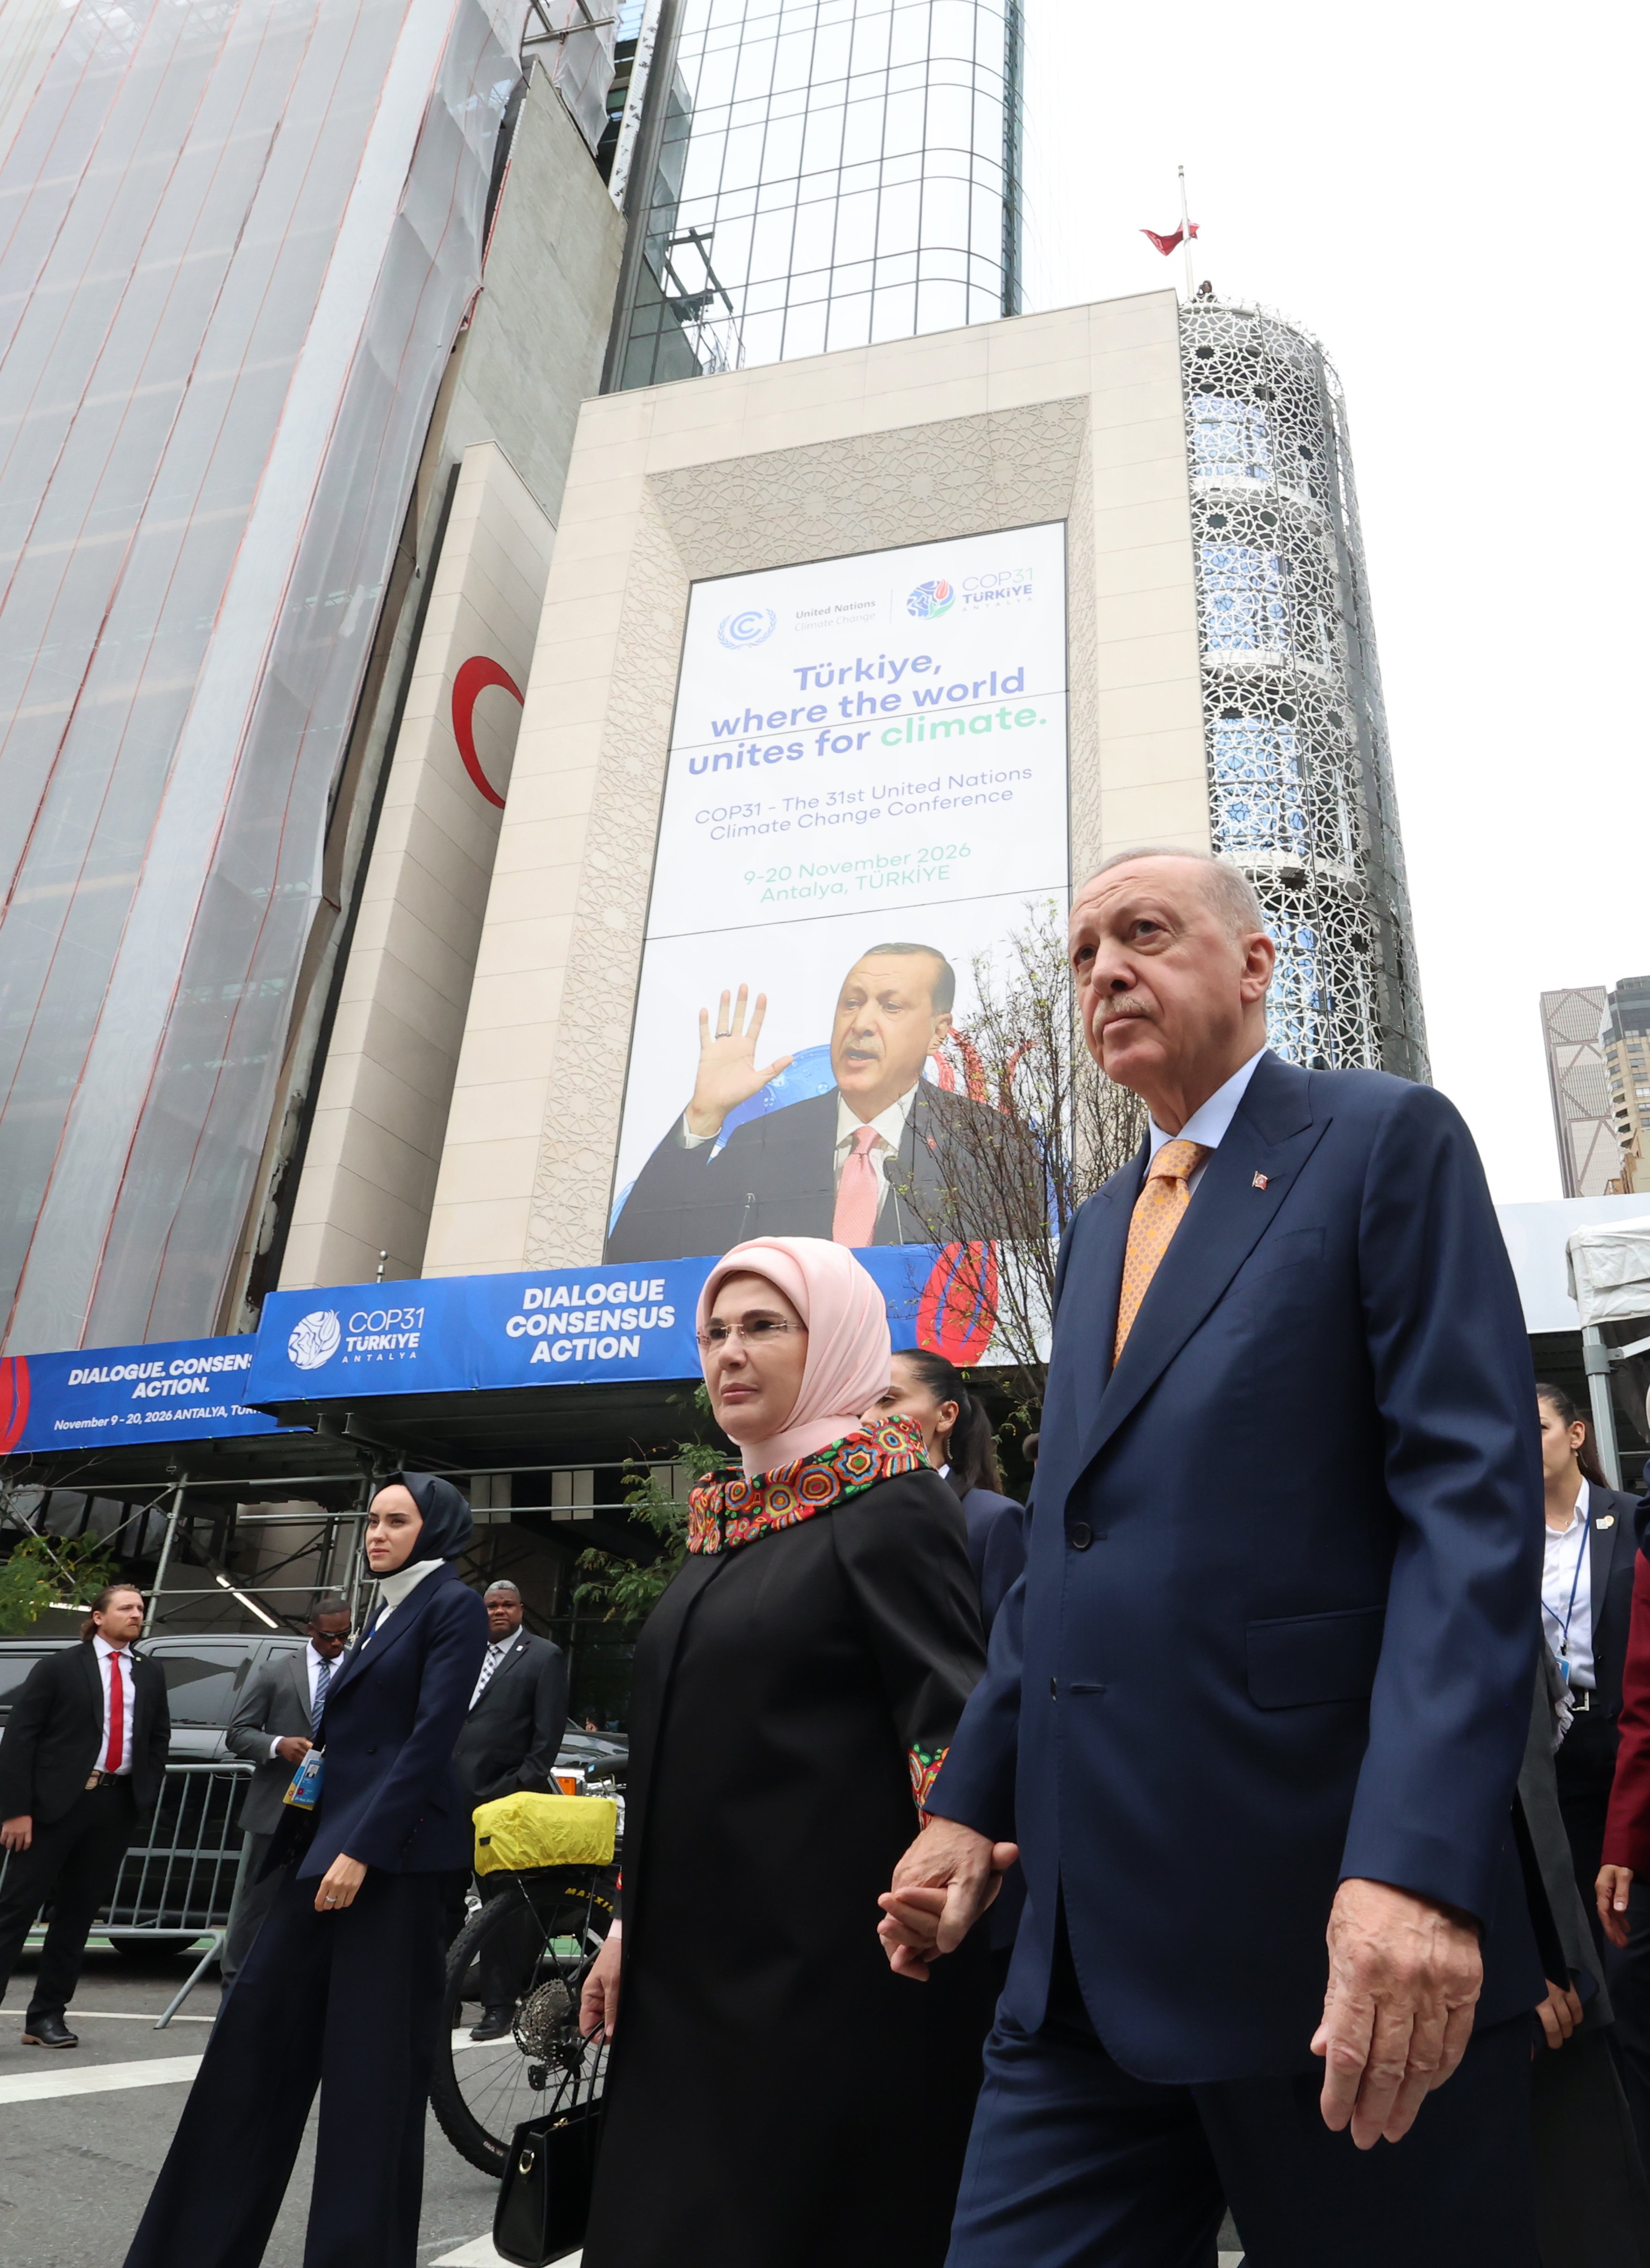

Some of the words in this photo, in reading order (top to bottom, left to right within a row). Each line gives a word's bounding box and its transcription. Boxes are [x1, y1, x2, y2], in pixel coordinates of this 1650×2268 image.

[962, 567, 1032, 591] COP31
[795, 619, 833, 632] Climate
[836, 613, 876, 625] Change
[796, 606, 831, 619] United
[834, 601, 876, 613] Nations
[793, 654, 941, 691] Türkiye,
[711, 705, 828, 737] where
[838, 691, 902, 718] the
[912, 666, 1024, 707] world
[688, 742, 804, 775] unites
[815, 729, 871, 756] for
[881, 706, 1047, 747] climate.
[695, 802, 760, 824] COP31
[782, 797, 819, 812] The
[826, 789, 865, 806] 31st
[872, 777, 940, 800] United
[948, 768, 1032, 789] Nations
[710, 820, 791, 840] Climate
[798, 808, 881, 828] Change
[888, 790, 1013, 816] Conference
[744, 866, 792, 885] 9-20
[799, 853, 911, 878] November
[917, 843, 972, 863] 2026
[760, 881, 848, 903] Antalya,
[855, 865, 950, 890] TÜRKİYE
[523, 1279, 665, 1310] DIALOGUE
[349, 1307, 425, 1333] COP31
[506, 1306, 675, 1337] CONSENSUS
[342, 1351, 416, 1363] ANTALYA
[530, 1335, 640, 1363] ACTION
[68, 1361, 166, 1385] DIALOGUE.
[132, 1376, 210, 1399] ACTION.
[54, 1417, 109, 1430] November
[111, 1415, 118, 1425] 9
[125, 1413, 142, 1425] 20,
[144, 1410, 173, 1423] 2026
[173, 1406, 228, 1420] ANTALYA,
